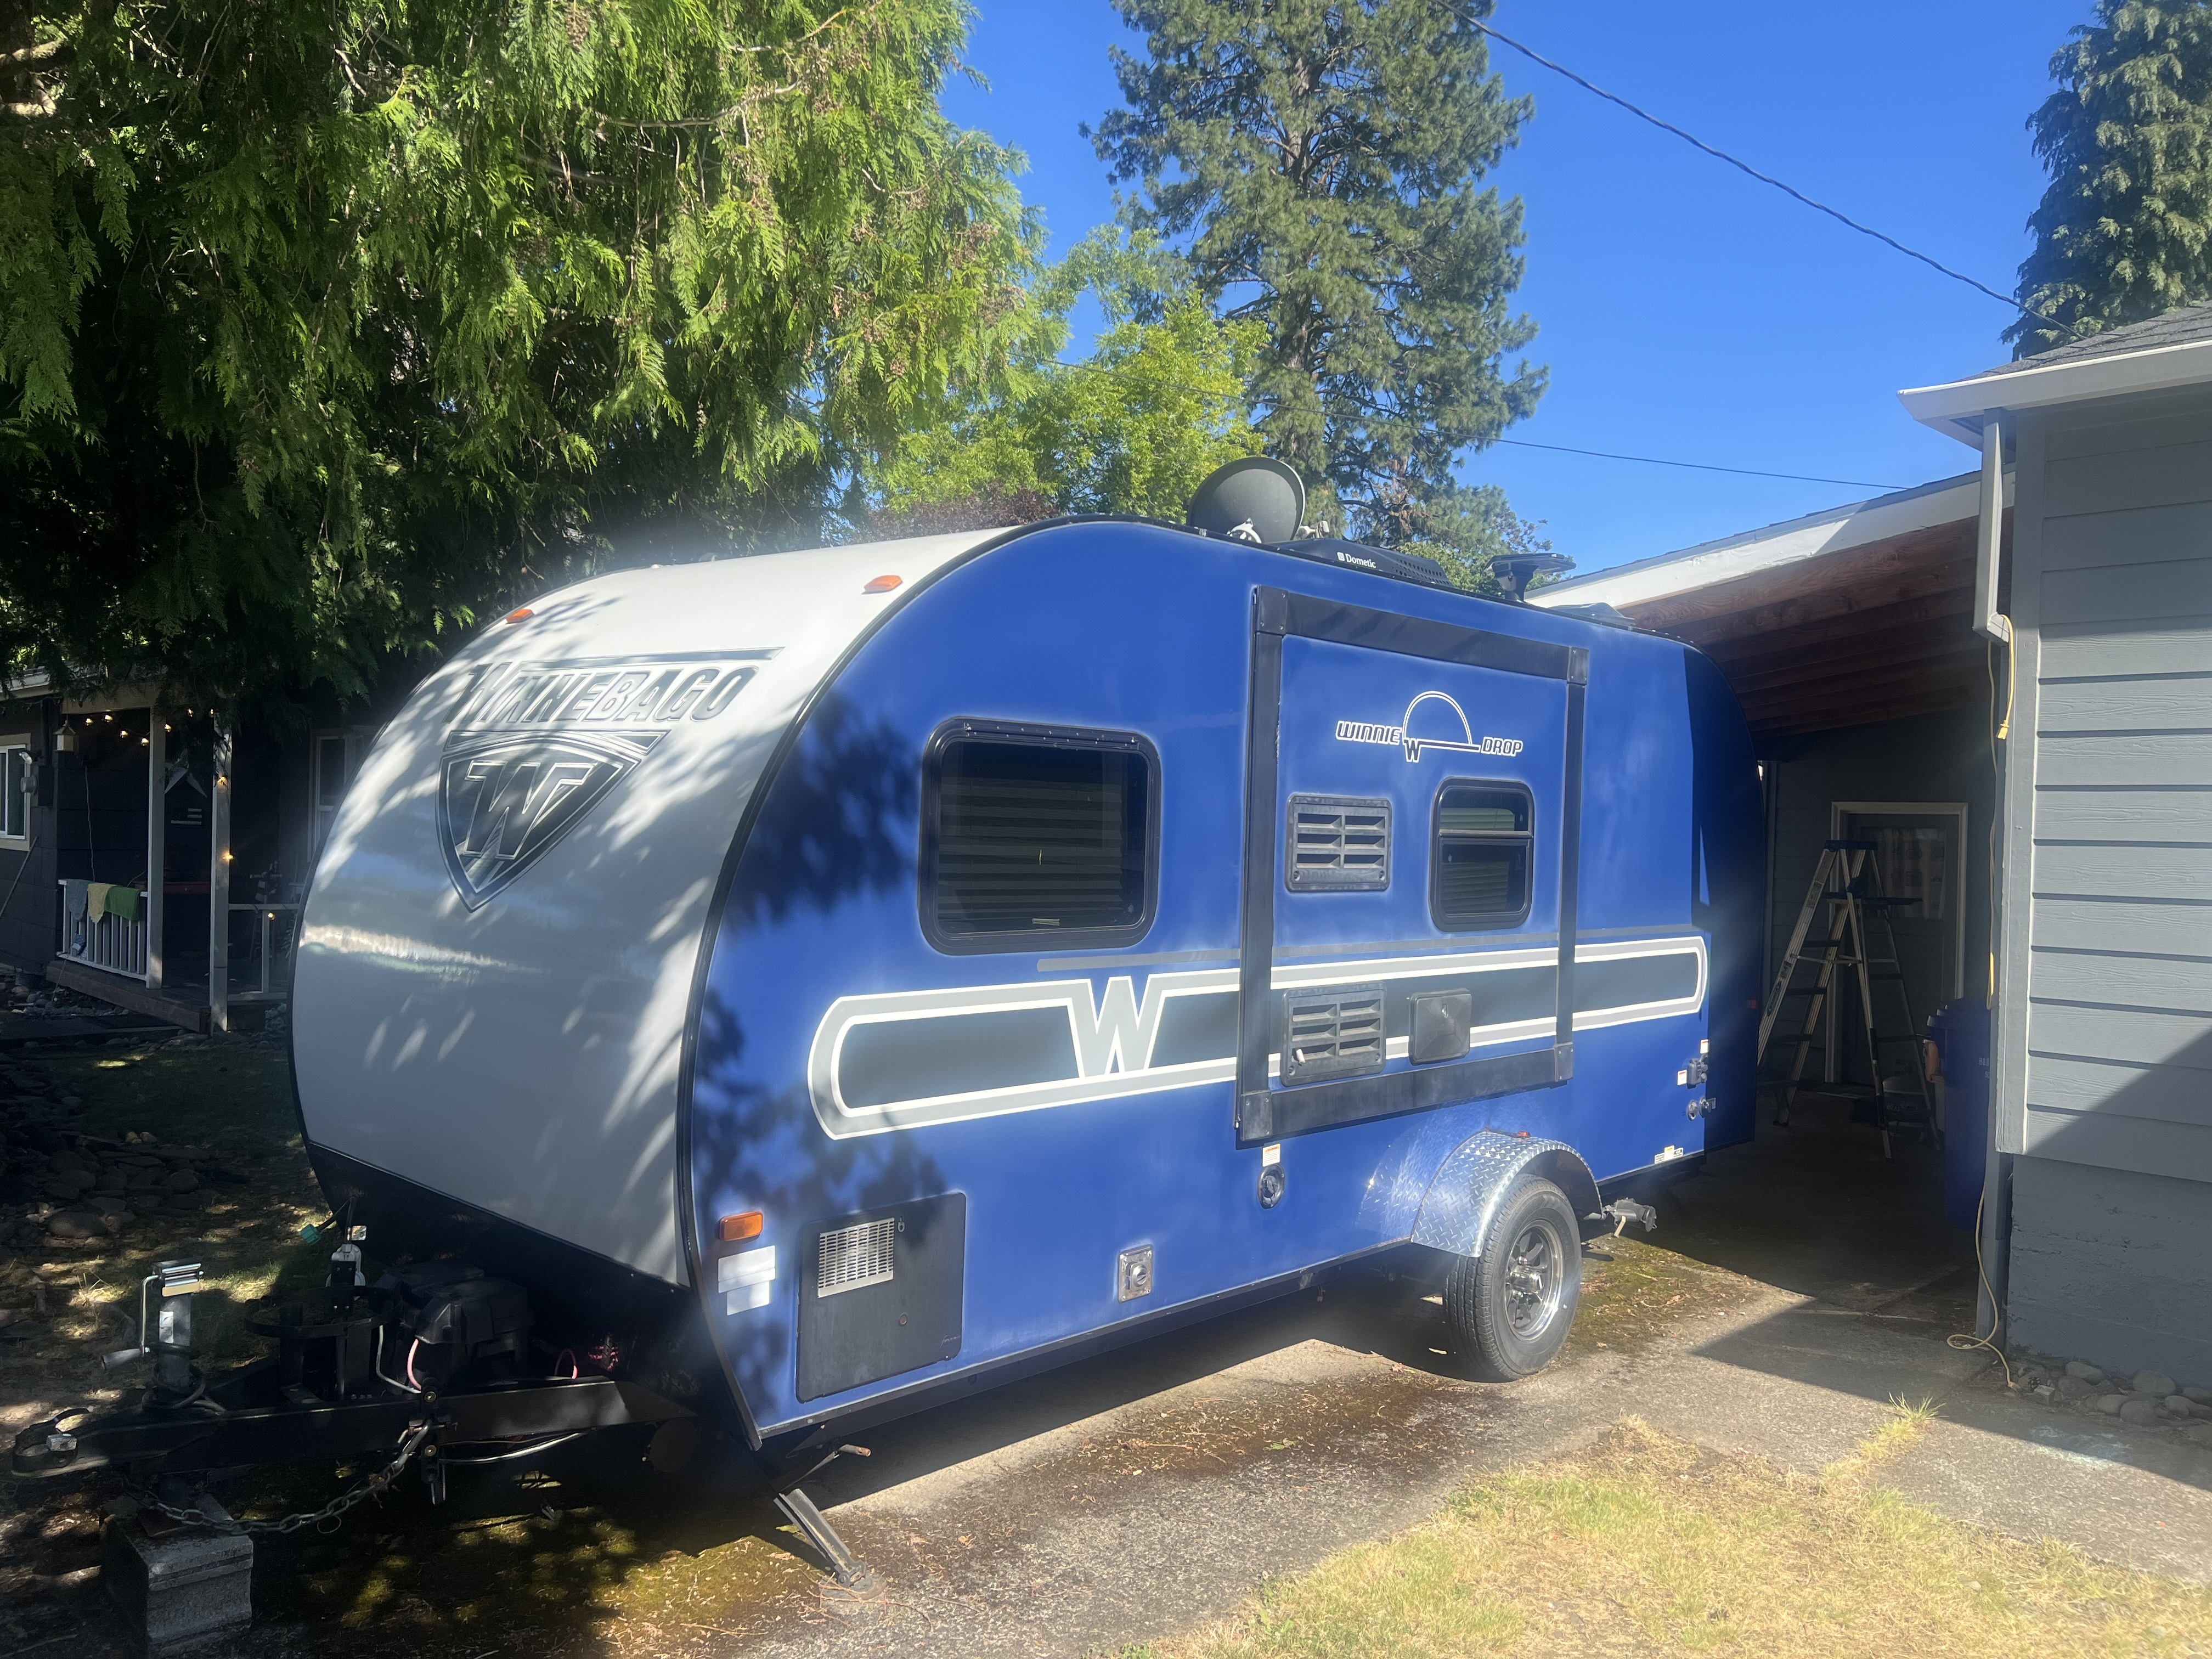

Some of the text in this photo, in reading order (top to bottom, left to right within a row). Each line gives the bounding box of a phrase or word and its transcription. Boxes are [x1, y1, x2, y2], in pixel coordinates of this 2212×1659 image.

[1345, 553, 1376, 568] Dometic
[442, 662, 759, 723] WINNEBAGO
[1335, 720, 1523, 757] WINNIE DROP
[464, 760, 600, 860] W
